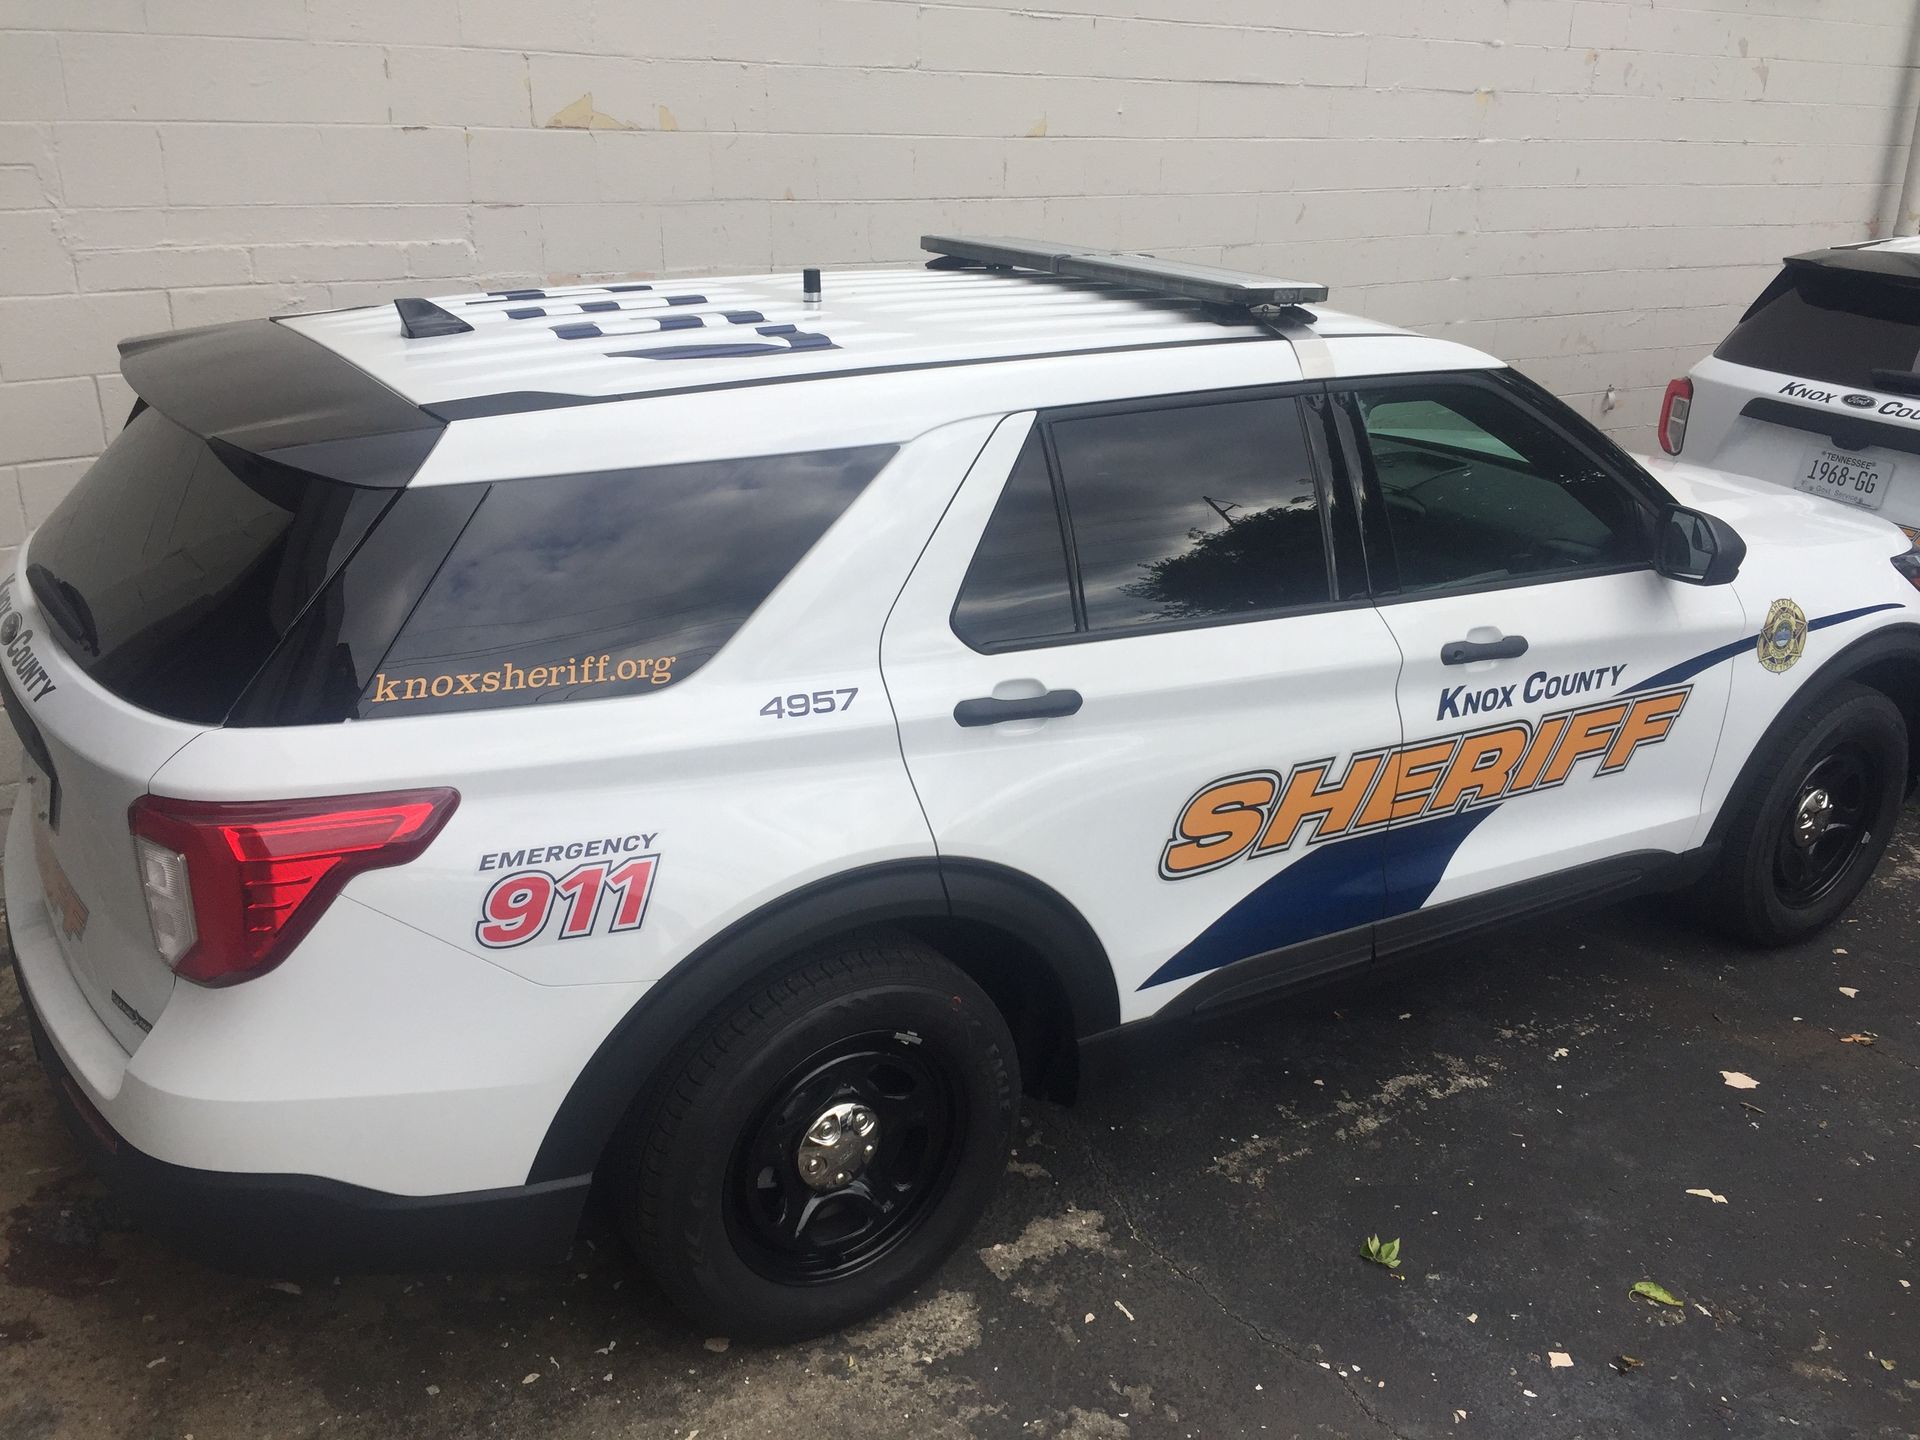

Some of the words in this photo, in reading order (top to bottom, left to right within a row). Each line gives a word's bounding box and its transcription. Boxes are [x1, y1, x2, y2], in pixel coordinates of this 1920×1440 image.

[1779, 381, 1838, 403] KNOX
[1807, 460, 1878, 494] 1968-GG
[1827, 452, 1873, 470] TENNESSEE
[7, 630, 57, 703] COUNTY
[372, 653, 676, 702] knoxsheriff.org
[759, 687, 859, 719] 4957
[1436, 684, 1518, 721] KNOX
[1523, 664, 1628, 703] COUNTY
[1157, 683, 1694, 882] SHERIFF
[478, 833, 658, 872] EMERGENCY
[475, 853, 661, 949] 911
